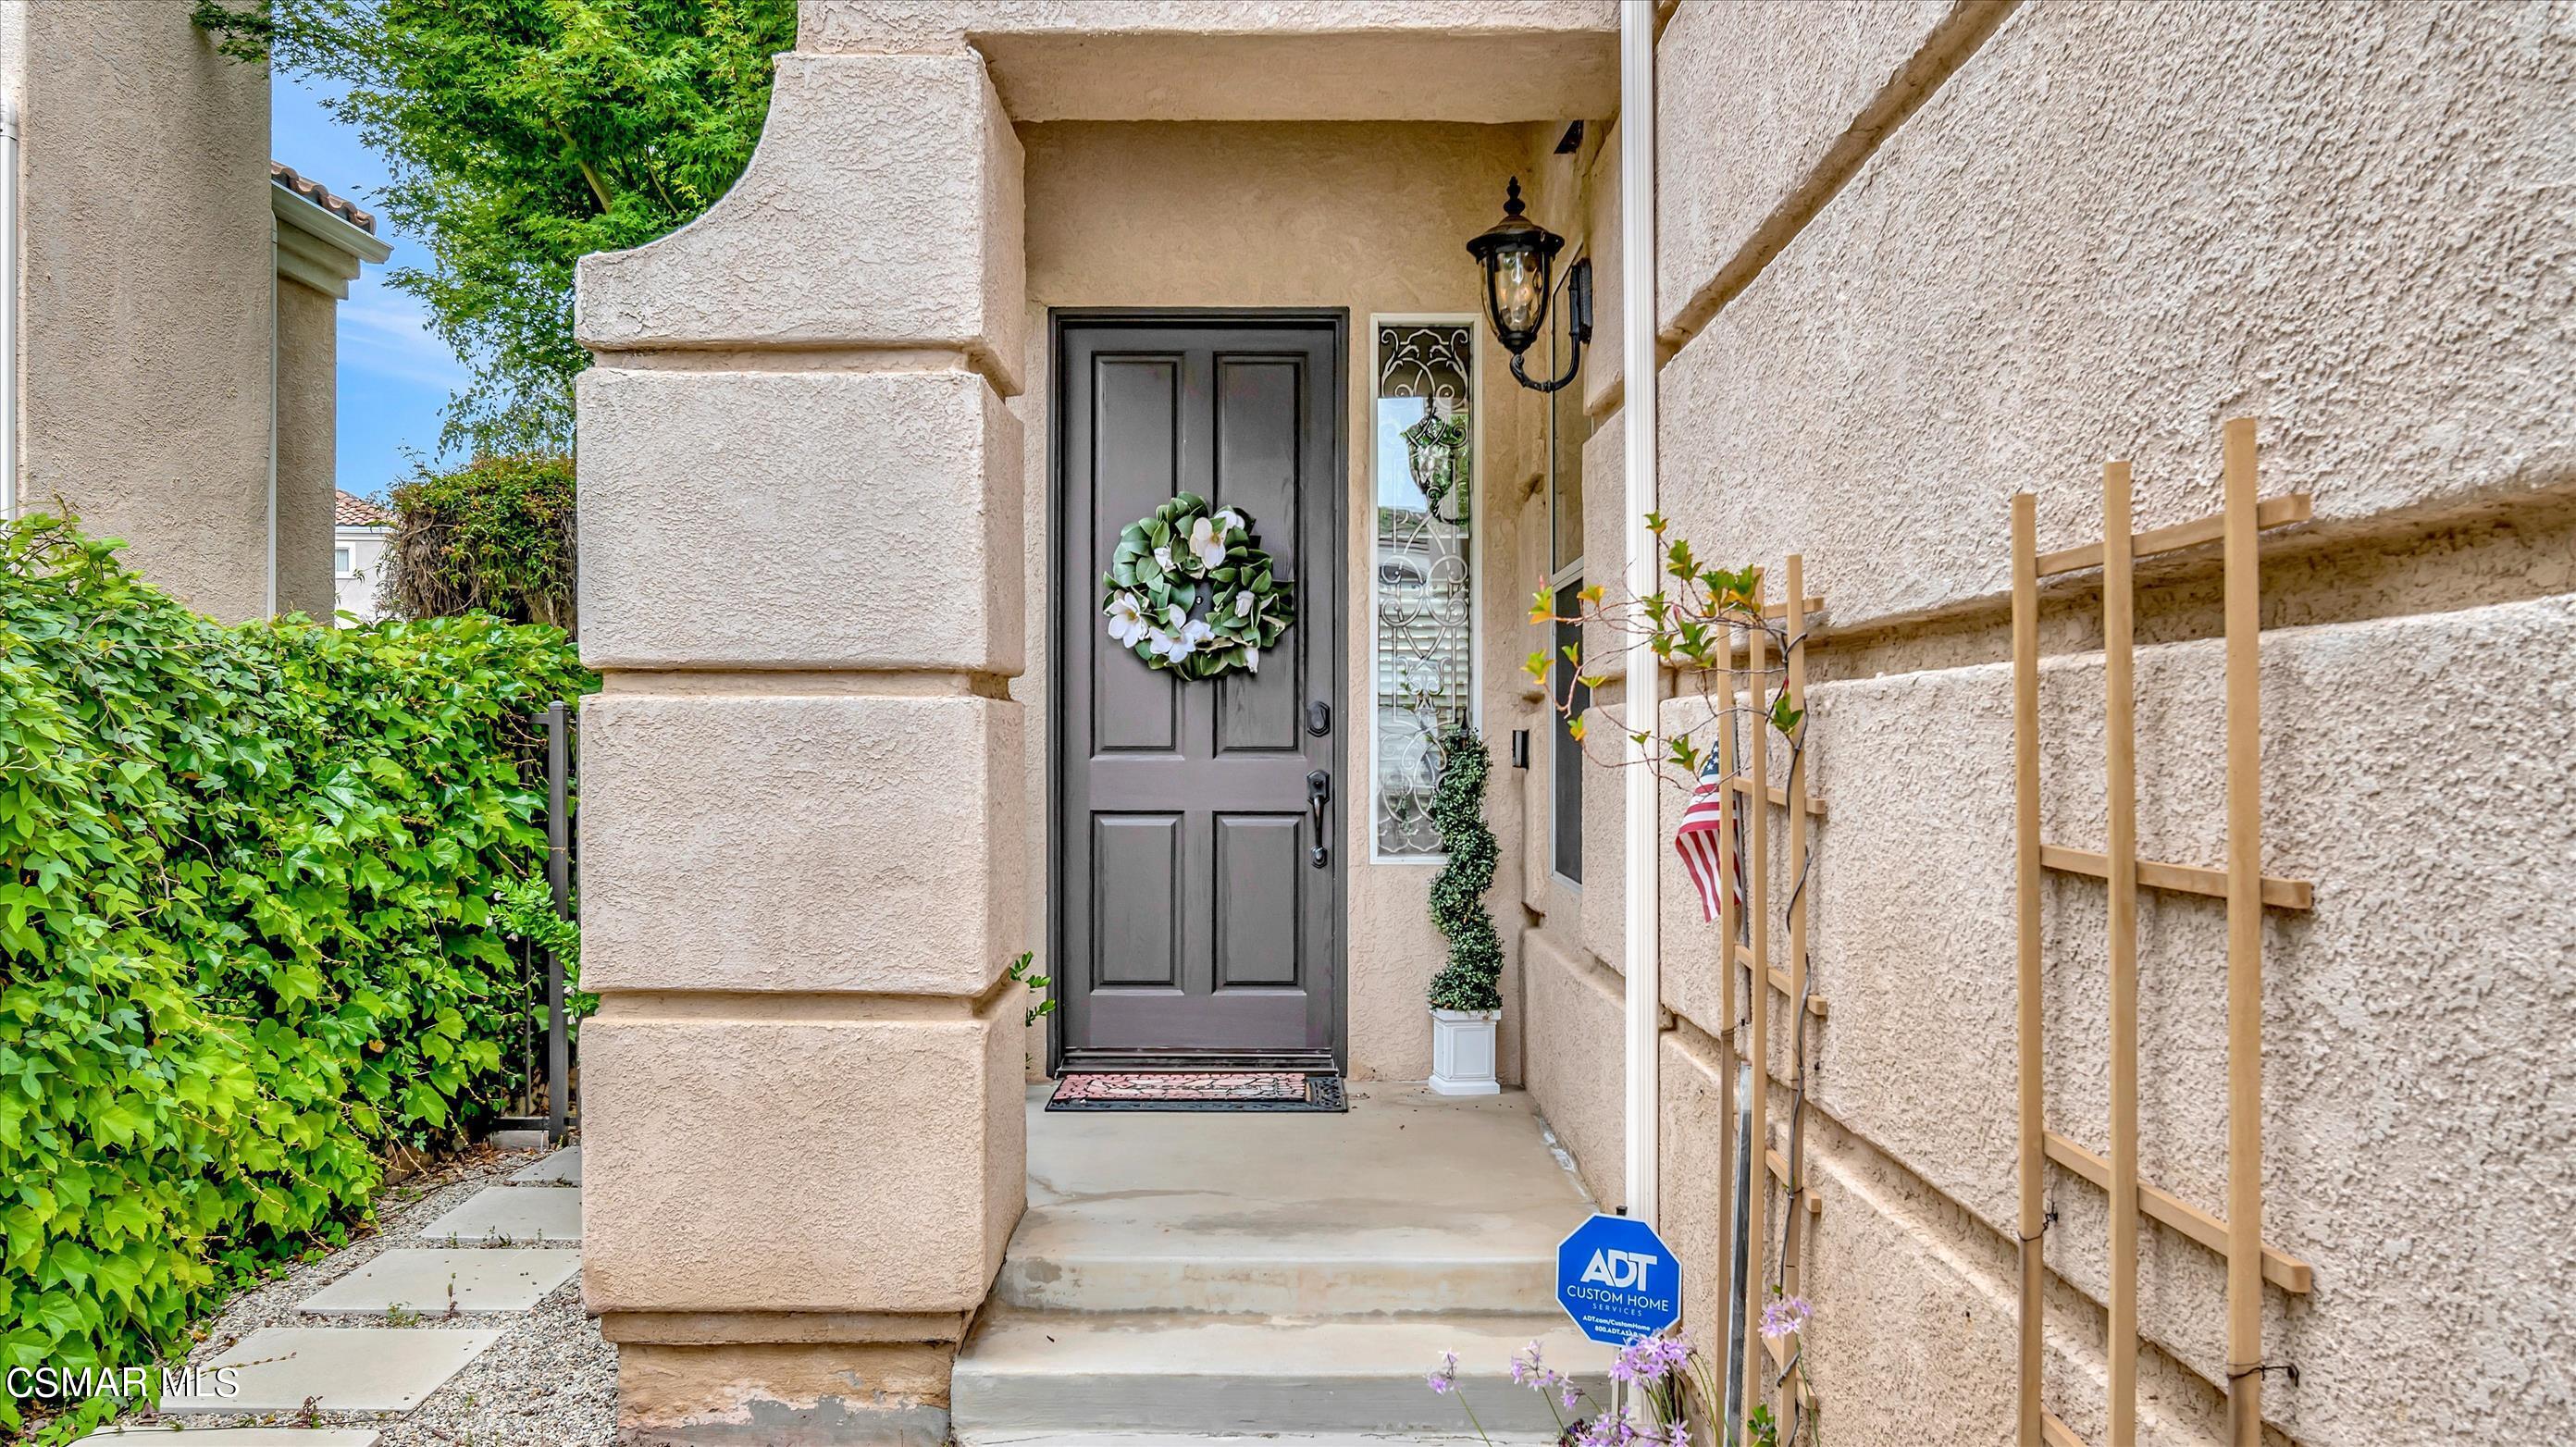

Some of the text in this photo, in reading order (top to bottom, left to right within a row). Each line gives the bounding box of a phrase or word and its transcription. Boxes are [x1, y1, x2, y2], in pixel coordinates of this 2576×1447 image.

[1579, 1247, 1657, 1292] ADT
[1567, 1285, 1668, 1312] CUSTOM HOME
[1592, 1303, 1642, 1317] SERVICES
[1582, 1315, 1651, 1331] ADT.com/CustomHome
